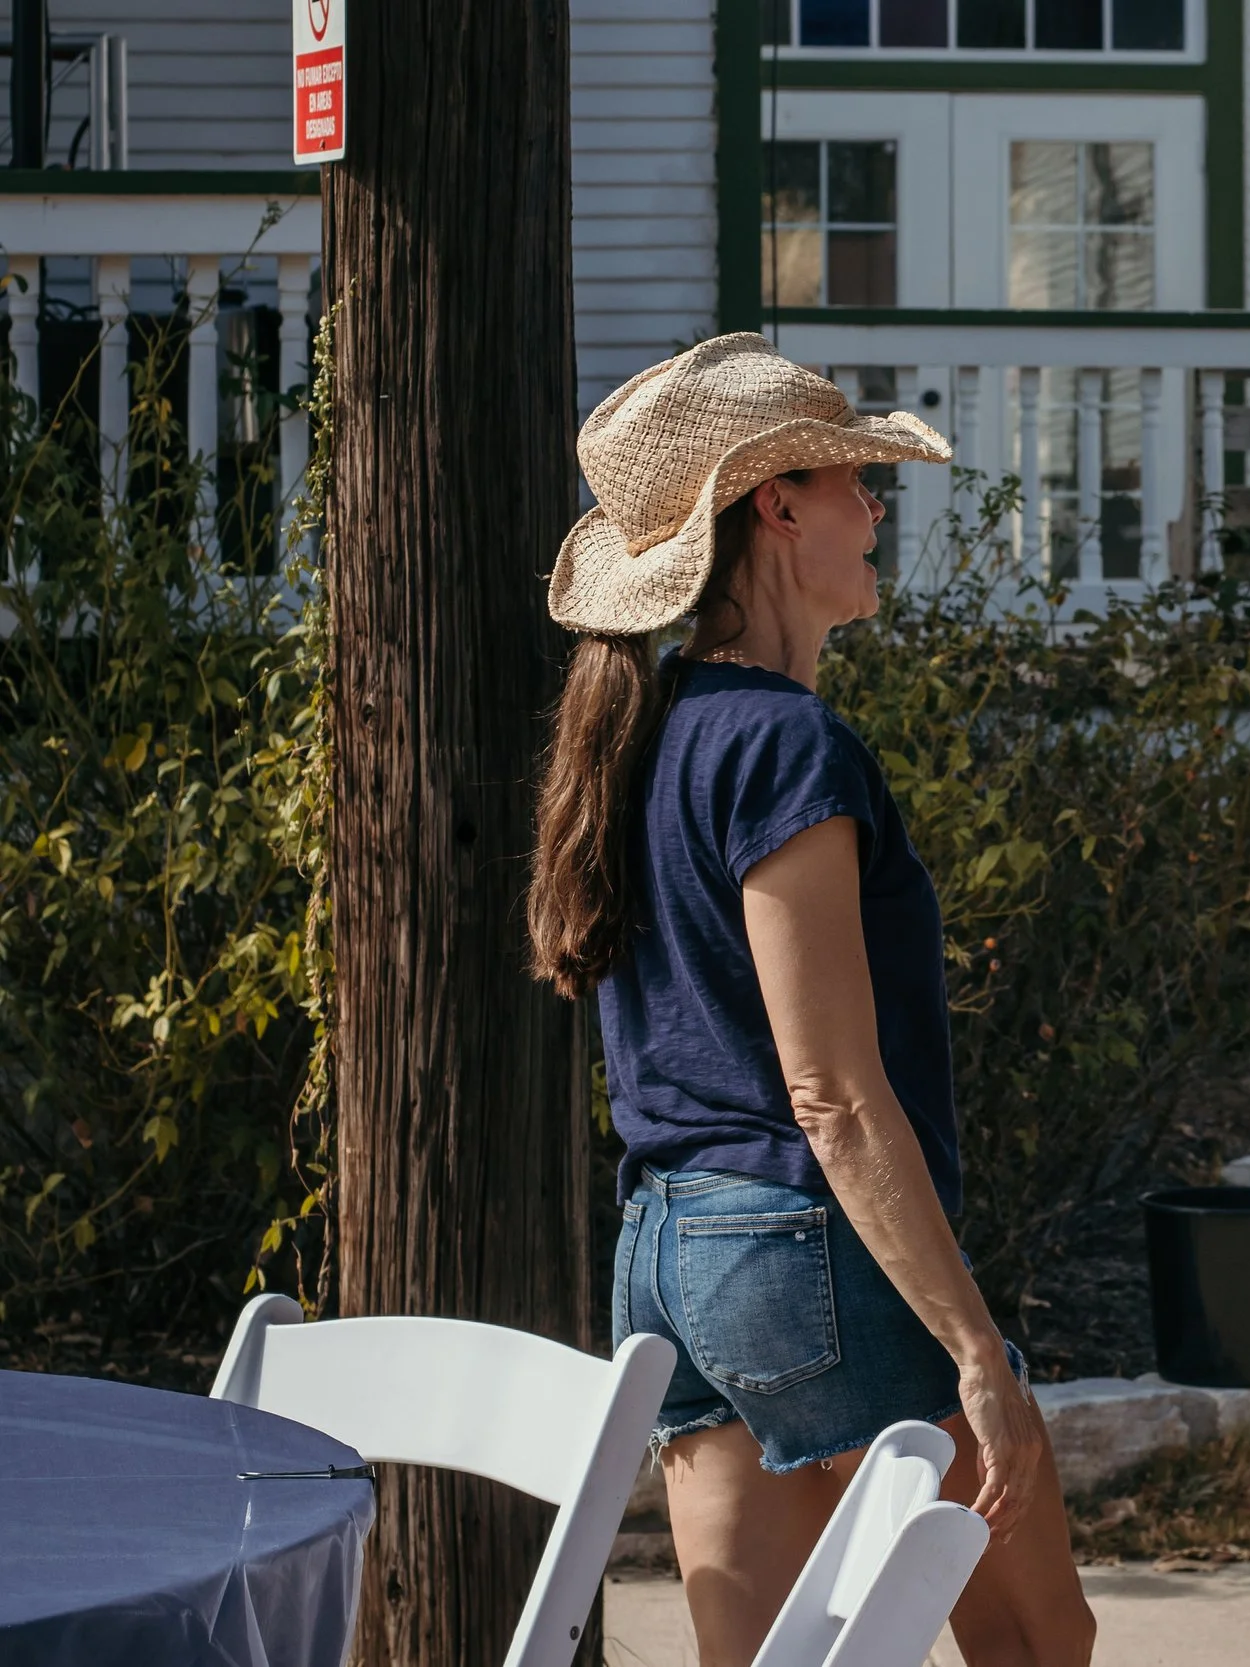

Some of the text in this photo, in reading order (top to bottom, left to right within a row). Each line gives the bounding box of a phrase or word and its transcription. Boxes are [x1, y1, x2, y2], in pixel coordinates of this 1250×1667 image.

[297, 61, 342, 88] NO FUMAR EXCEPTO
[309, 93, 316, 113] EN
[306, 116, 335, 140] DESIGNADAS
